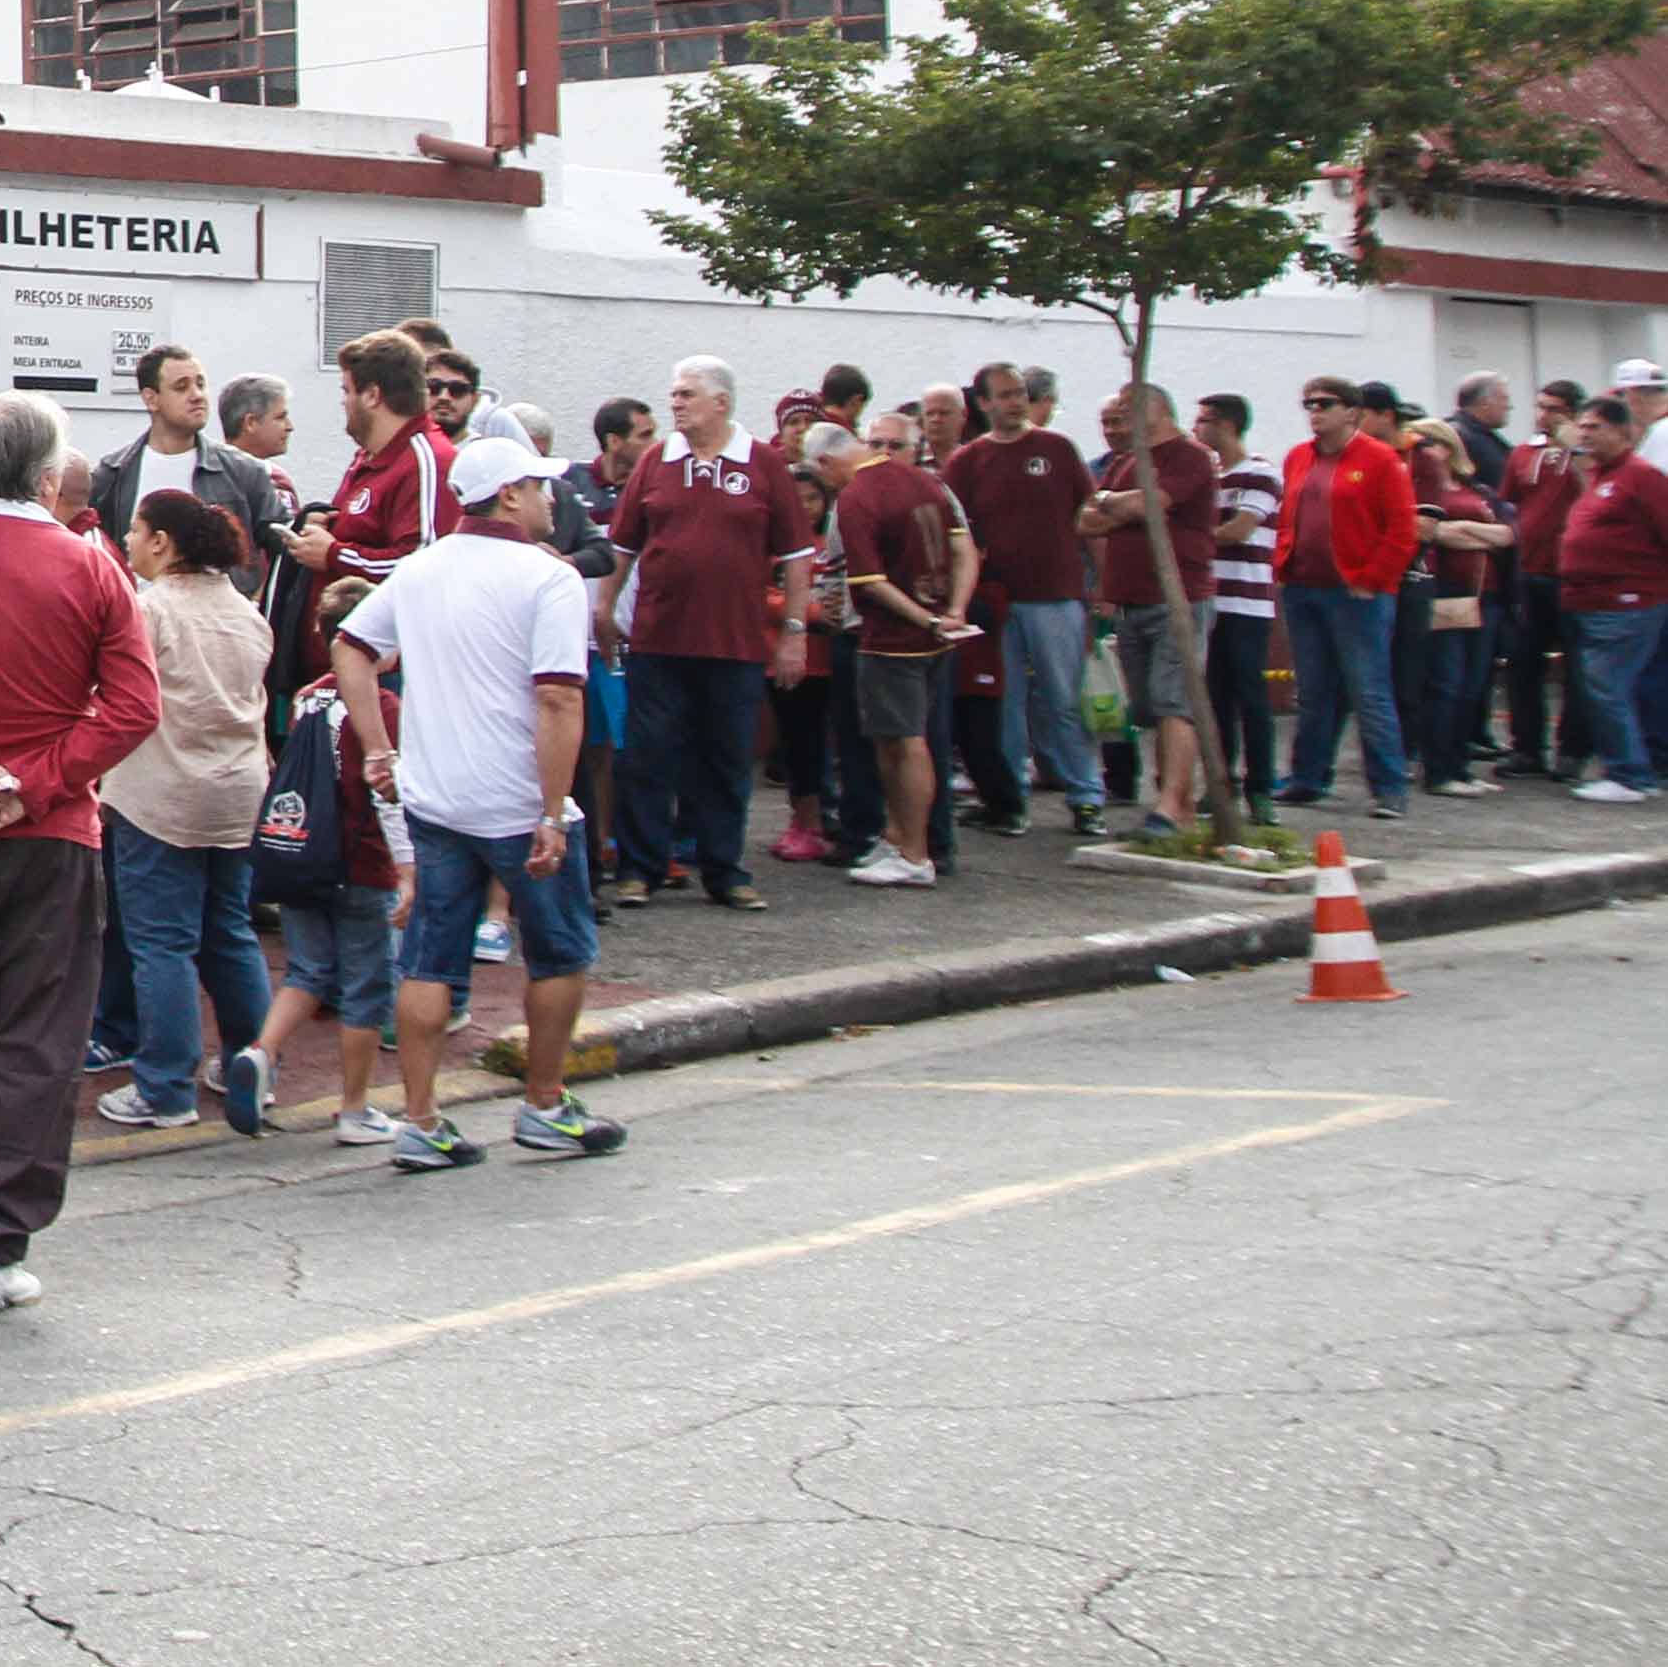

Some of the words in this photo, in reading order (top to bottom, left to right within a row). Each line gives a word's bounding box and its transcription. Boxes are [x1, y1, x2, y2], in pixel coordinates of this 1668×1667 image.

[14, 289, 64, 308] PREÇOS
[67, 292, 84, 307] DE
[87, 293, 154, 311] INGRESSOS
[13, 335, 50, 347] INTEIRA
[12, 356, 37, 368] MEIA
[40, 357, 82, 369] ENTRADA
